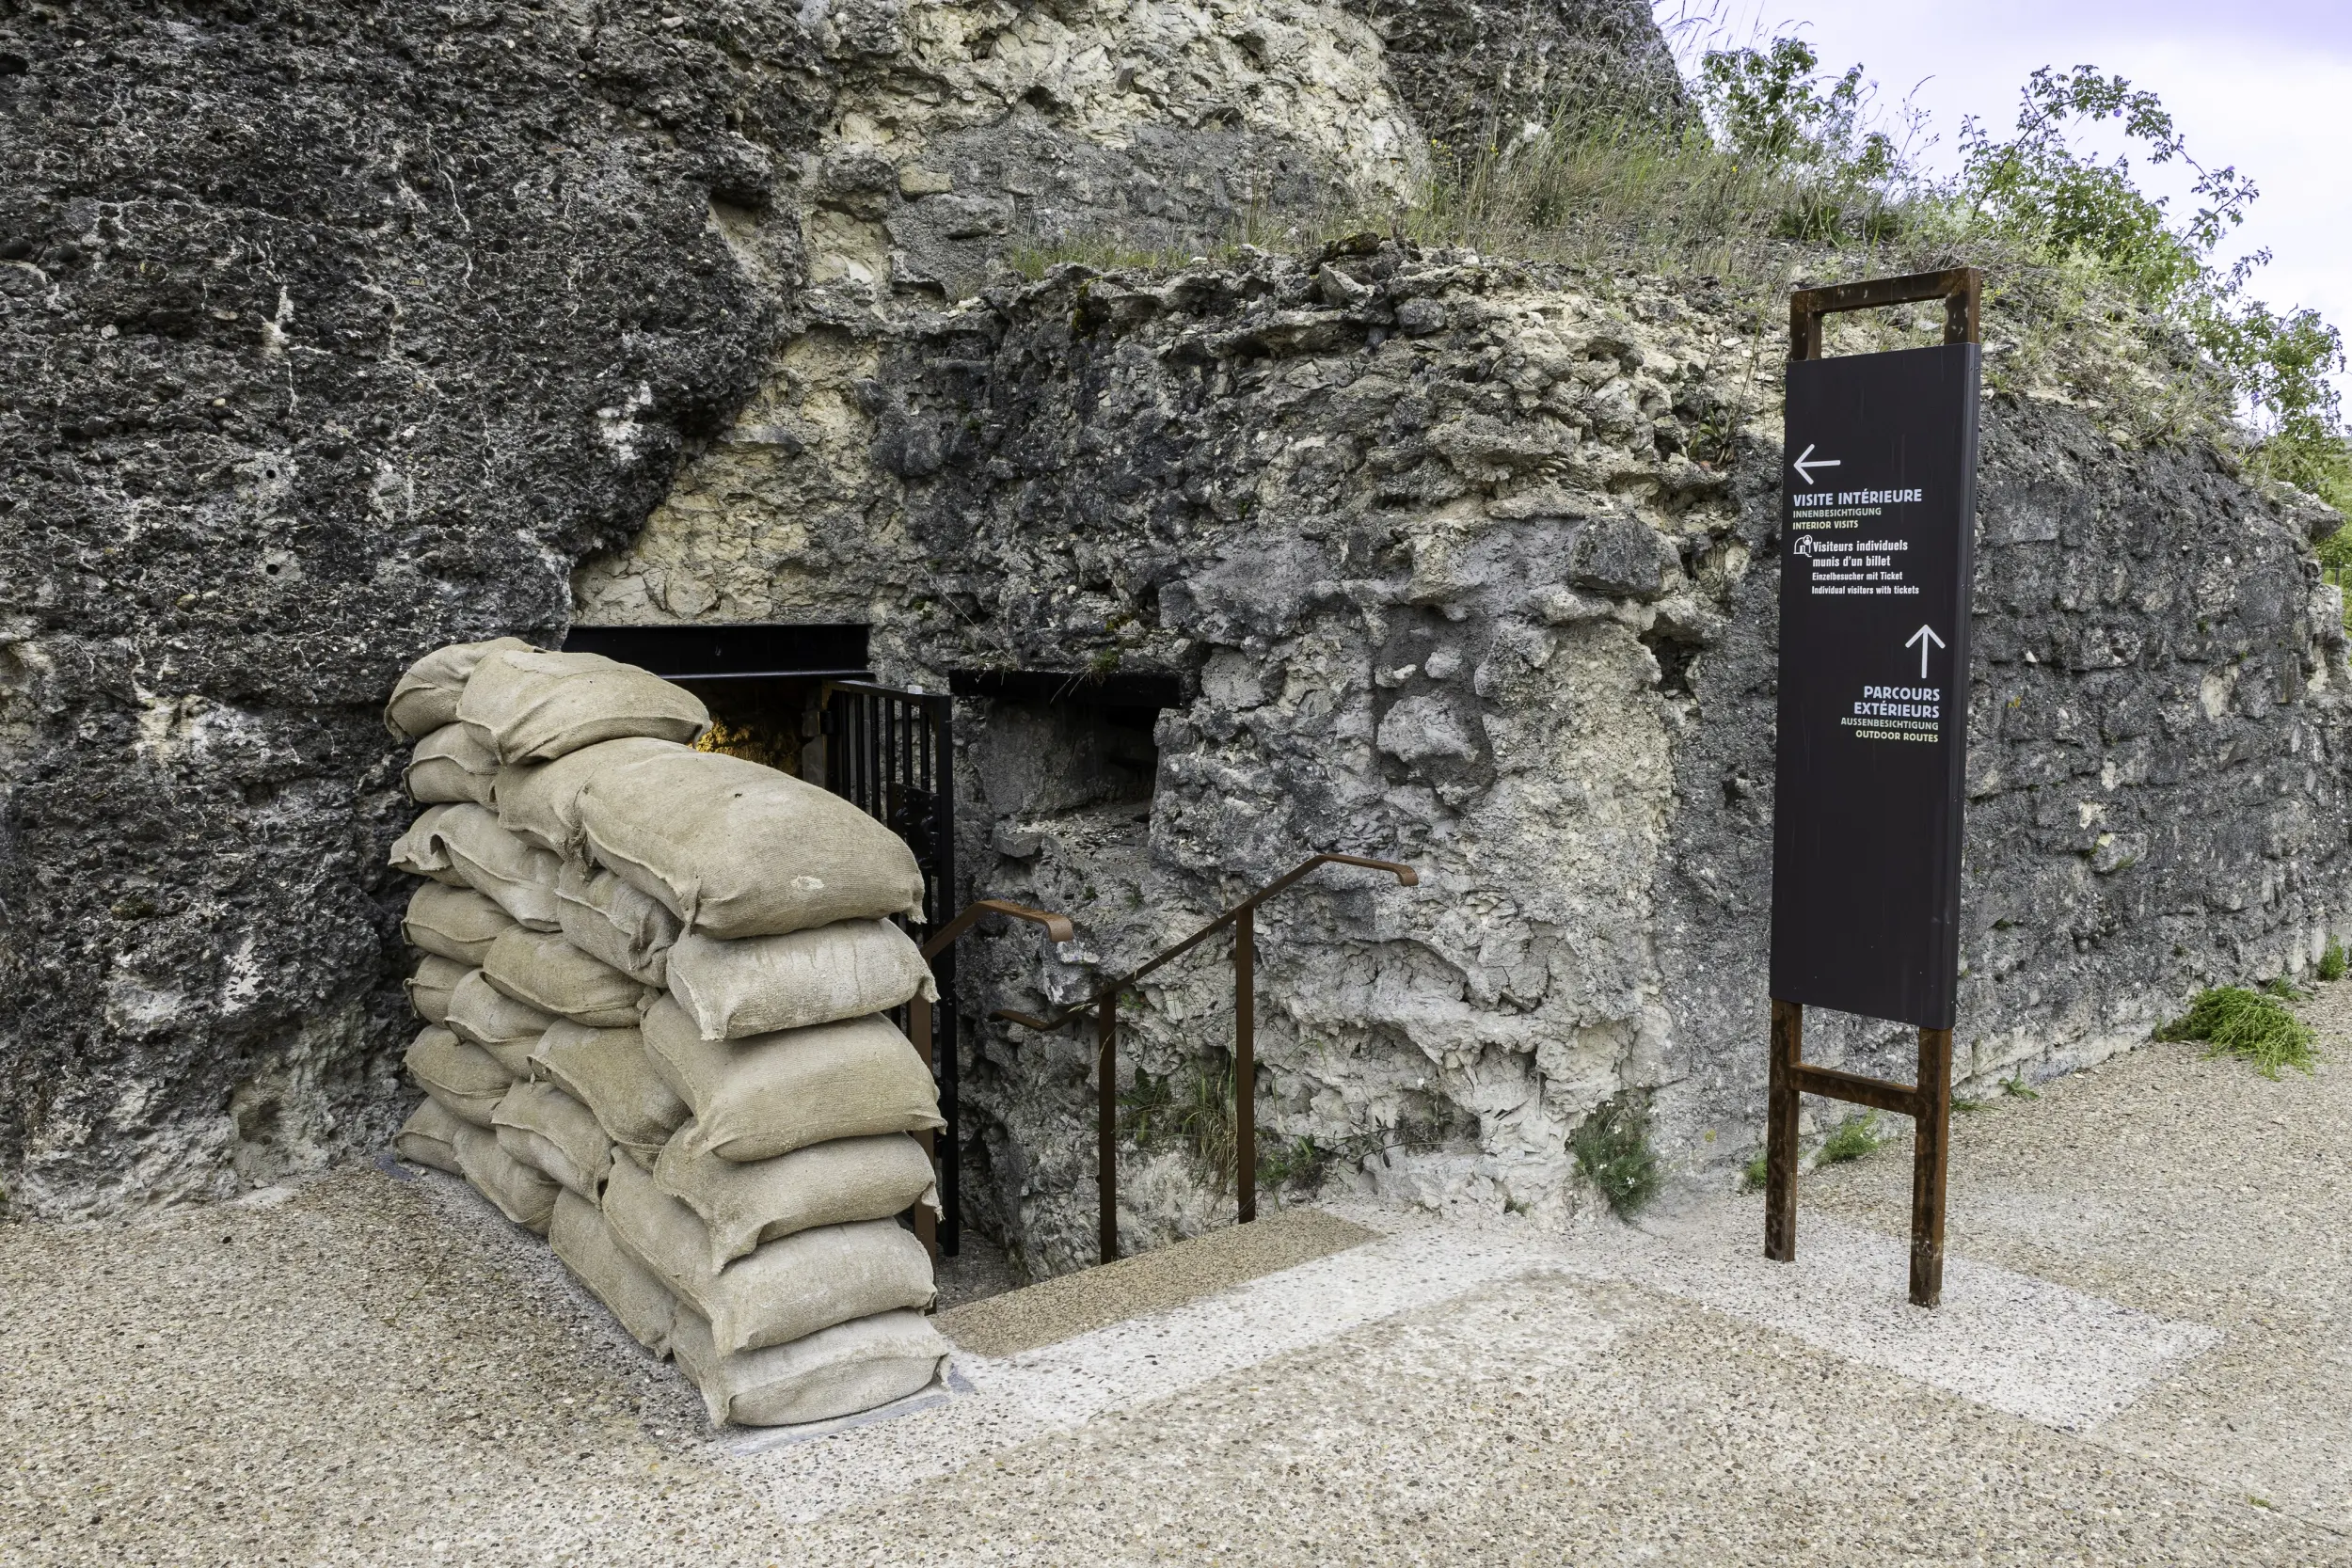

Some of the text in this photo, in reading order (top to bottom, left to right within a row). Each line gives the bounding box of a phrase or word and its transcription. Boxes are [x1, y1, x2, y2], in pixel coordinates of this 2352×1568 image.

[1793, 488, 1922, 506] VISITE INTÉRIEURE
[1793, 507, 1882, 518] INNENBESICHTIGUNG
[1792, 520, 1858, 530] INTERIOR VISITS
[1813, 540, 1908, 552] Visiteurs individuels
[1813, 557, 1839, 567] munis
[1867, 556, 1891, 566] billet
[1812, 572, 1902, 580] Einzelbesucher mit Ticket
[1812, 586, 1919, 594] Individual visitors with tickets
[1864, 686, 1940, 701] PARCOURS
[1854, 701, 1939, 718] EXTÉRIEURS
[1841, 718, 1938, 730] AUSSENBESICHTIGUNG
[1856, 730, 1938, 742] OUTDOOR ROUTES
